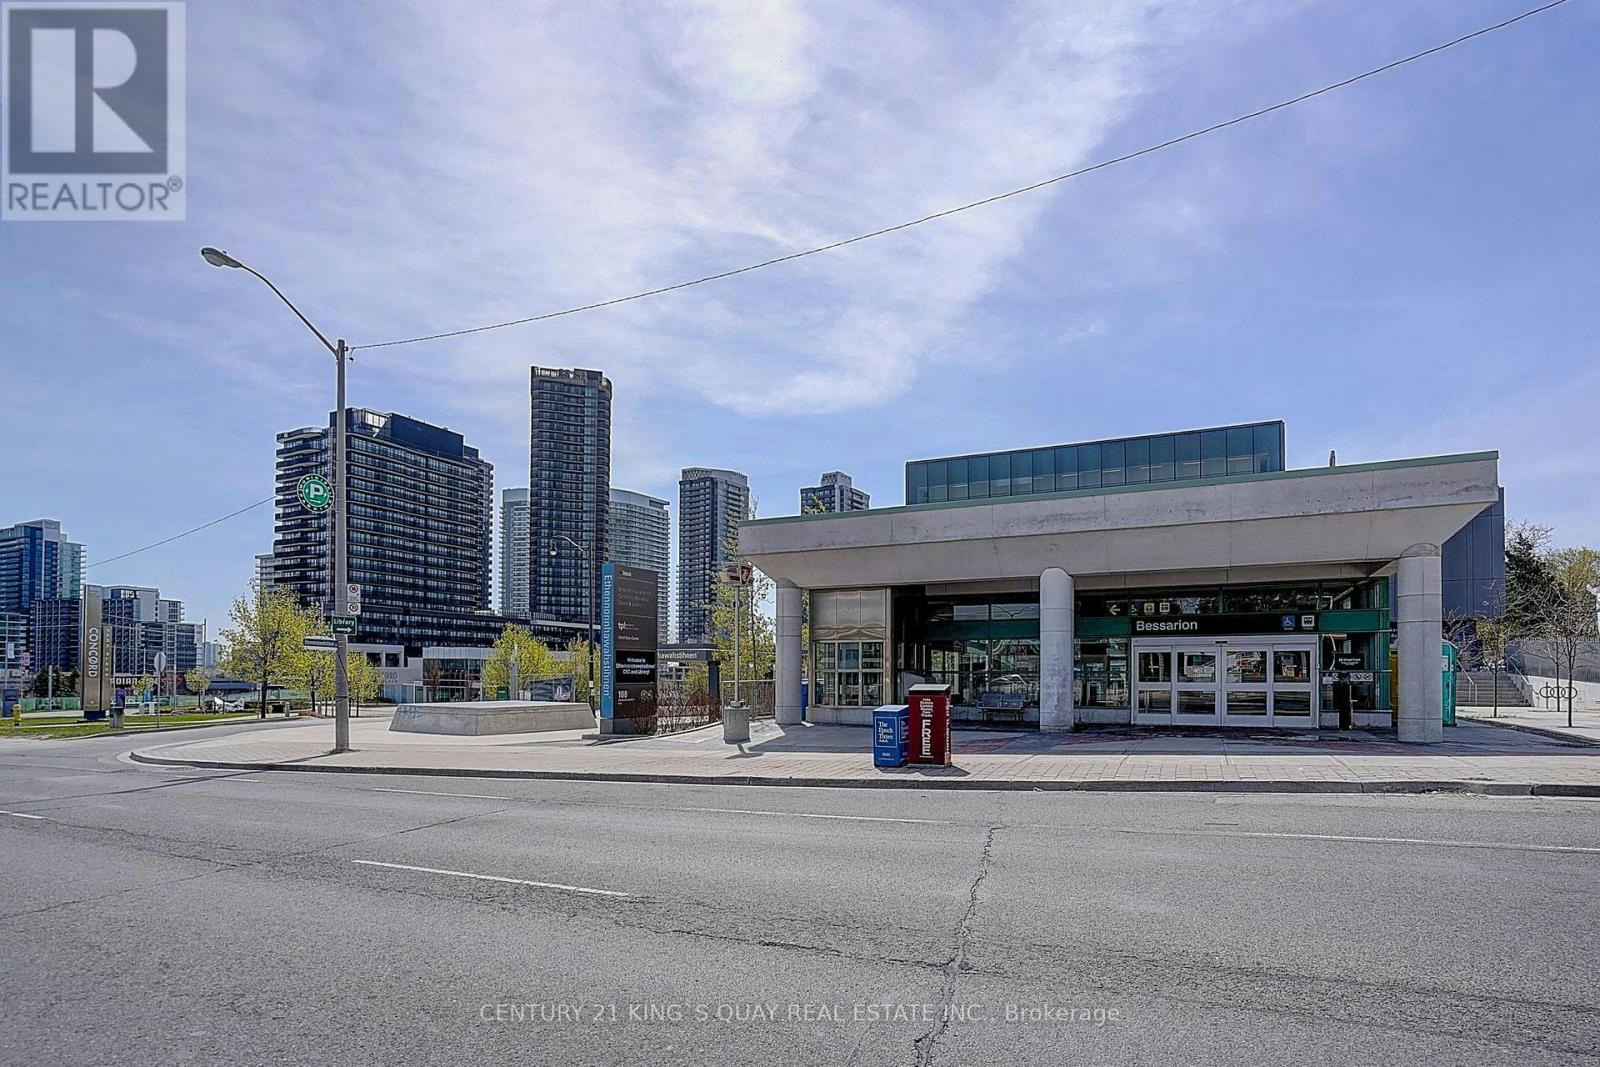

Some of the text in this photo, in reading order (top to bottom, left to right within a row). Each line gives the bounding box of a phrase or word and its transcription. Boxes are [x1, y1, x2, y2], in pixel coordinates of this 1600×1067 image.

[310, 483, 324, 499] P
[333, 617, 355, 627] Library
[1135, 619, 1198, 631] Bessarion
[922, 719, 932, 756] FREE
